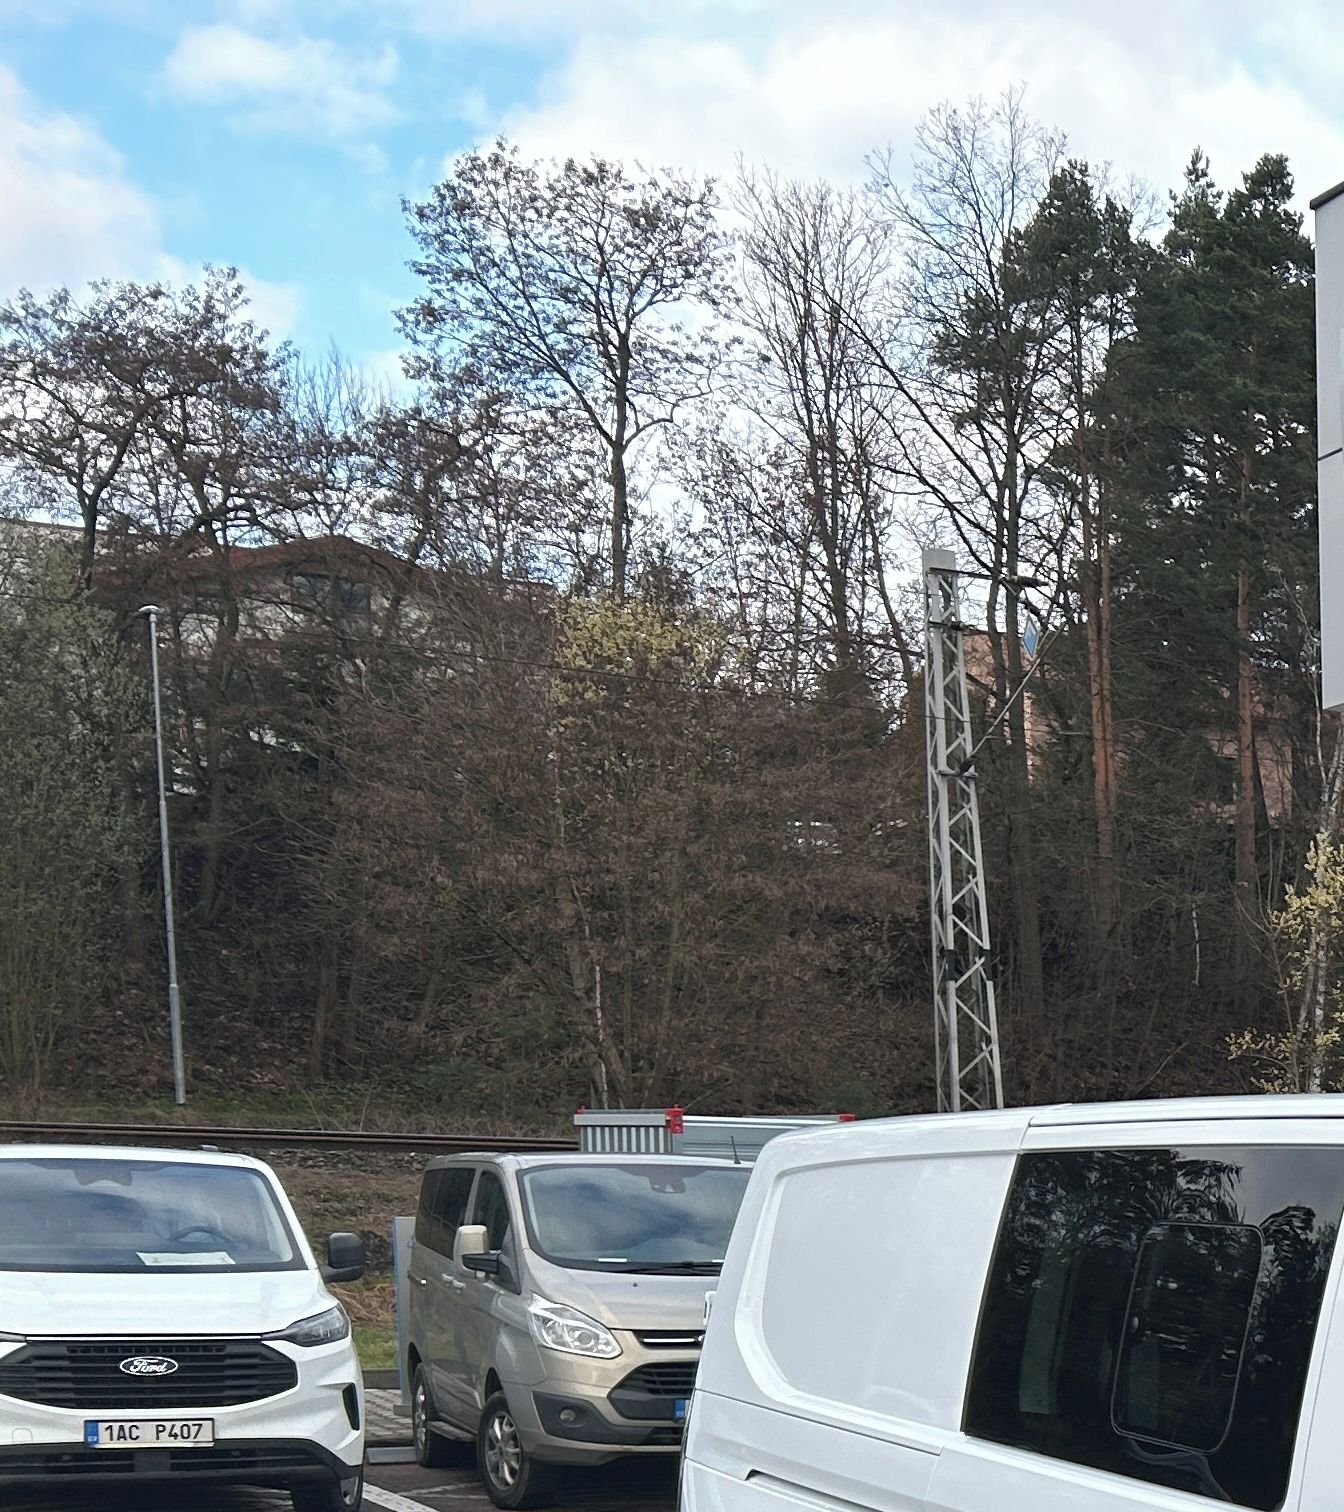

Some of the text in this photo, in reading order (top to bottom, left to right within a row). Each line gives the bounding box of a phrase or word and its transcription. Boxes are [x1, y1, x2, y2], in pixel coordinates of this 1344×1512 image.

[130, 1359, 168, 1374] Ford
[105, 1423, 203, 1442] 1AC P407
